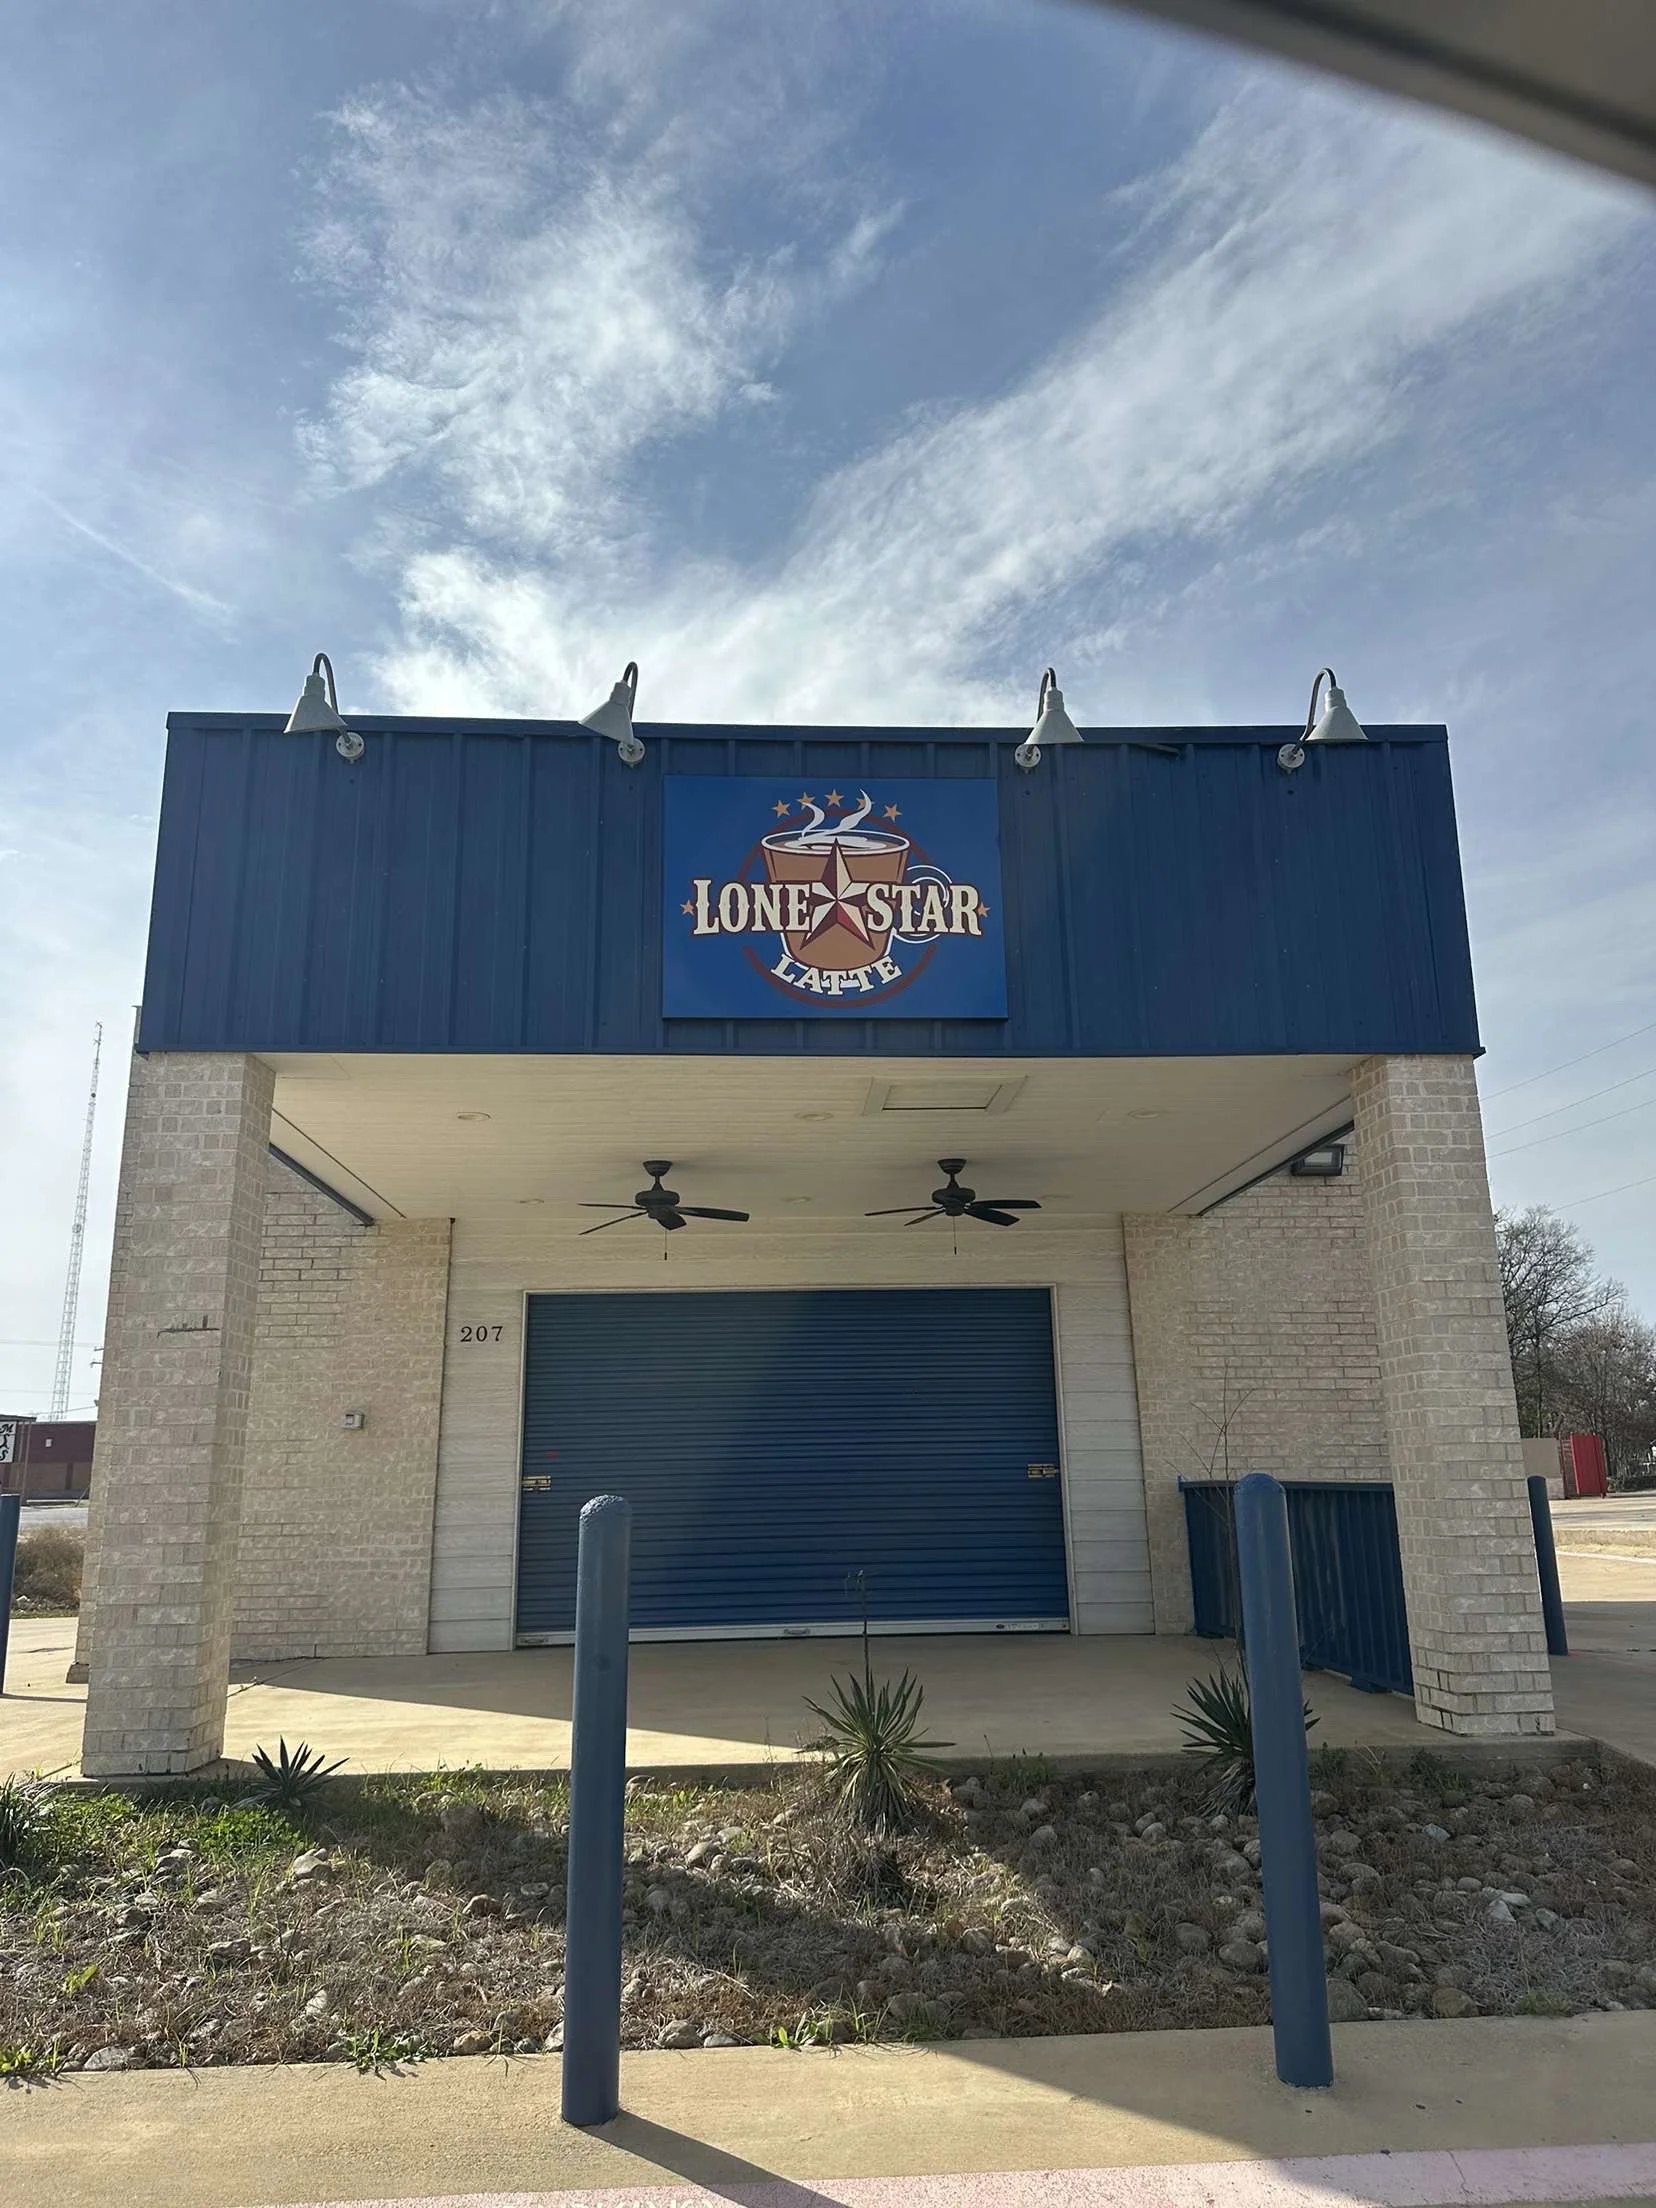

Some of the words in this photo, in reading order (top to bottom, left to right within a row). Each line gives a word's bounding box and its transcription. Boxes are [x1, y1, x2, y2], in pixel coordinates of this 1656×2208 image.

[693, 879, 811, 935] LONE
[866, 884, 982, 935] STAR
[770, 953, 902, 995] LATTE
[460, 1325, 503, 1342] 207
